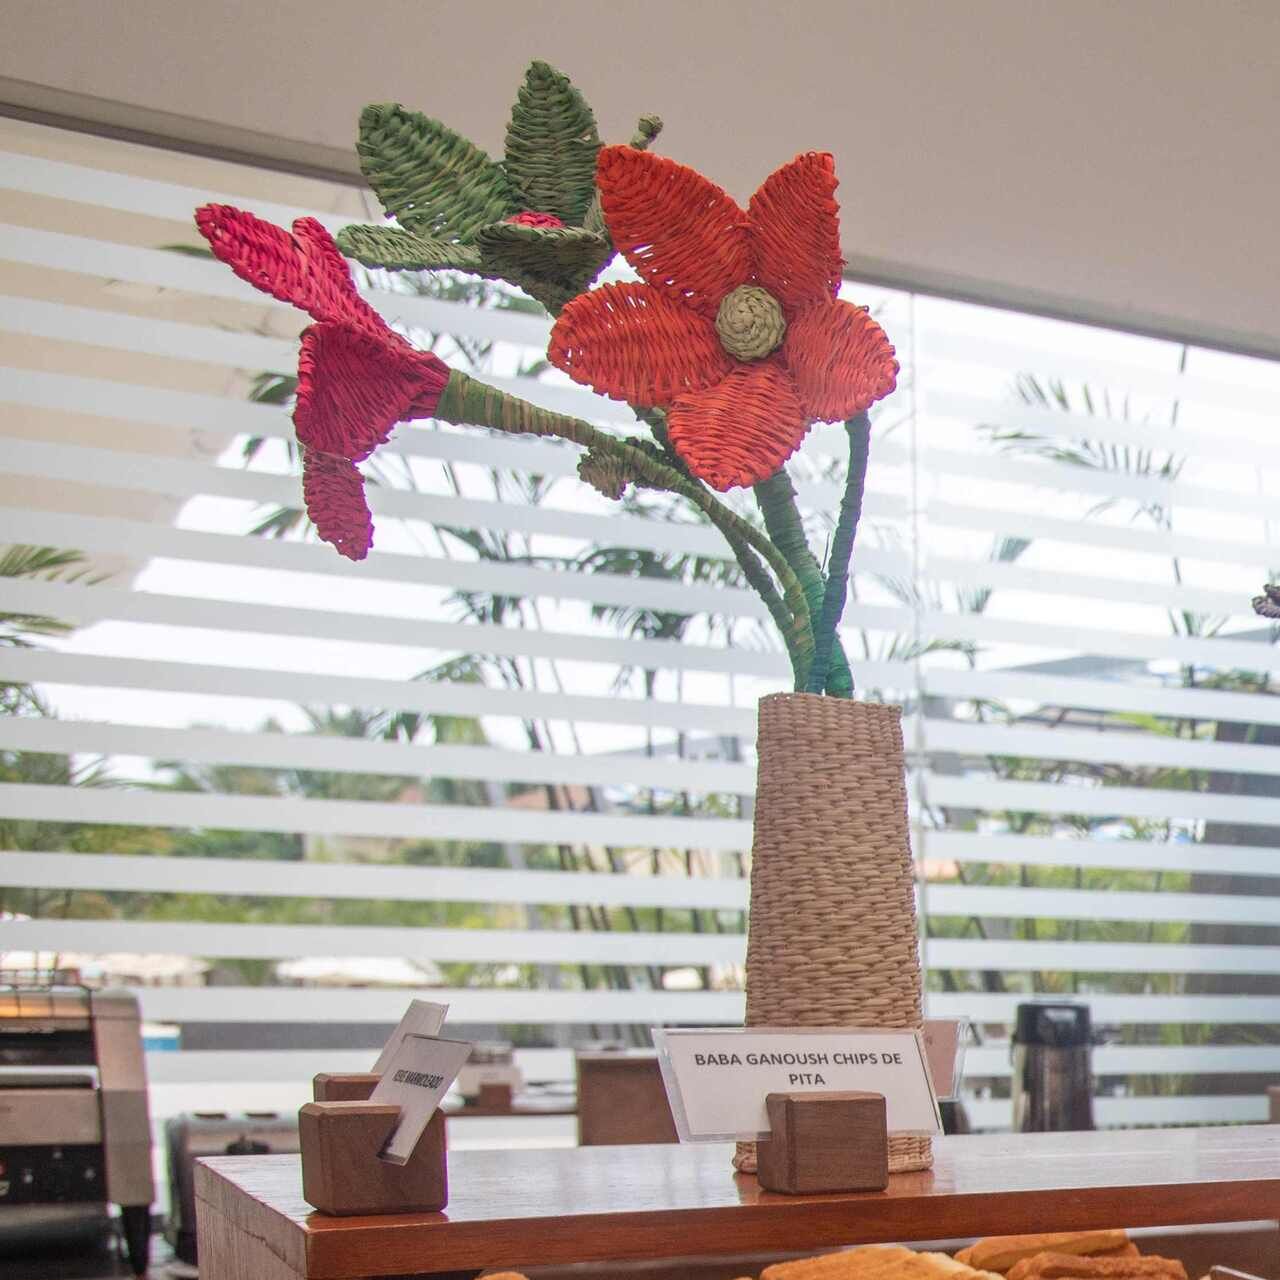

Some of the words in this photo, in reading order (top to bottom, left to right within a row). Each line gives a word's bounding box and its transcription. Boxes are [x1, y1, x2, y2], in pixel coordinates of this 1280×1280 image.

[694, 1052, 742, 1067] BABA
[746, 1051, 829, 1066] GANOUSH
[833, 1052, 878, 1066] CHIPS
[883, 1052, 903, 1064] DE
[788, 1073, 825, 1086] PITA
